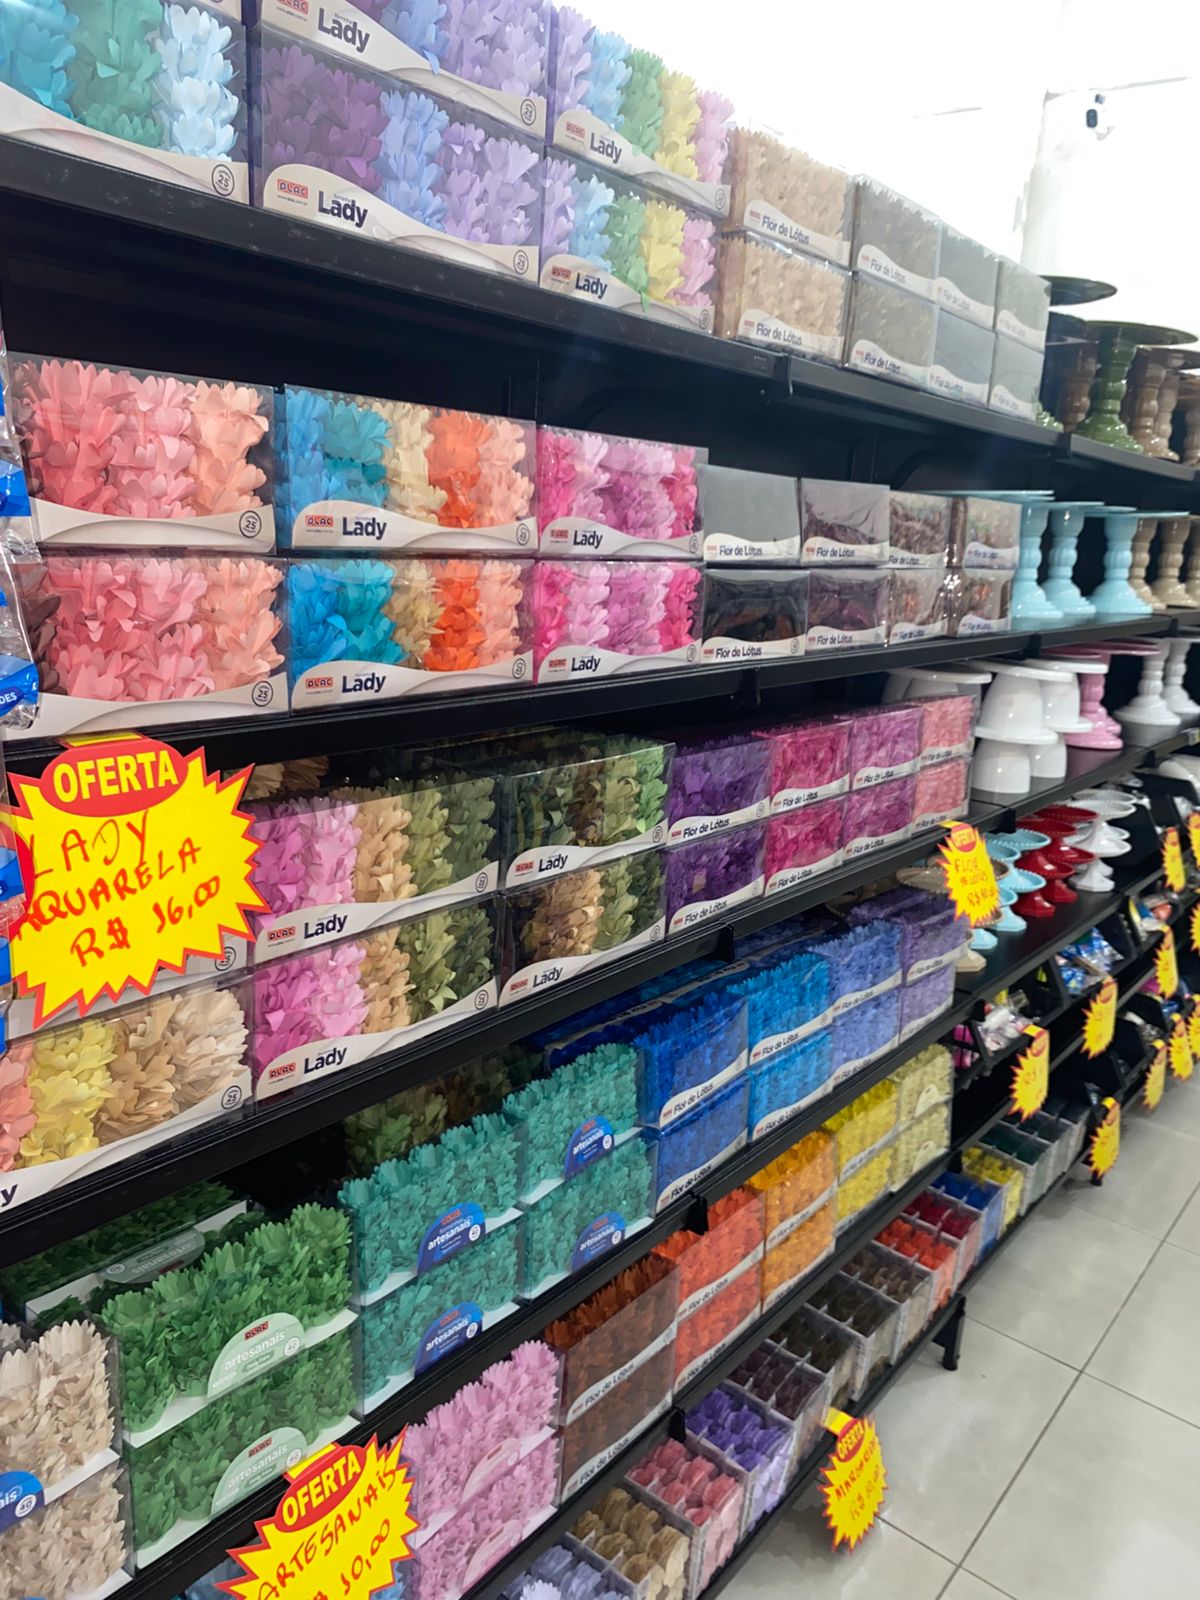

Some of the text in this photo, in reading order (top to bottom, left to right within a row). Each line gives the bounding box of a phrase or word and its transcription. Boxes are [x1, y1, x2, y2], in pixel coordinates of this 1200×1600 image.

[319, 8, 370, 53] Lady
[591, 133, 622, 163] Lady
[318, 191, 368, 228] Lady
[762, 216, 777, 232] Flor
[576, 273, 608, 299] Lady
[756, 323, 771, 339] Flor
[343, 517, 386, 540] Lady
[574, 530, 602, 549] Lady
[719, 545, 732, 556] Flor
[816, 547, 828, 558] Flor
[715, 646, 732, 659] Flor
[572, 656, 600, 673] Lady
[342, 673, 386, 693] Lady
[54, 750, 179, 803] OFERTA
[683, 817, 730, 839] Flor de Lótus
[539, 854, 567, 872] Lady
[304, 914, 347, 939] Lady
[685, 911, 699, 925] Flor
[533, 967, 562, 988] Lady
[304, 1048, 347, 1074] Lady
[674, 1102, 686, 1115] Flor
[428, 1218, 473, 1250] artesanais
[426, 1317, 470, 1351] artesanais
[224, 1330, 286, 1371] artesanais
[228, 1444, 288, 1489] artesanais
[282, 1450, 362, 1526] OFERTA
[258, 1463, 397, 1600] ARTESANAIS
